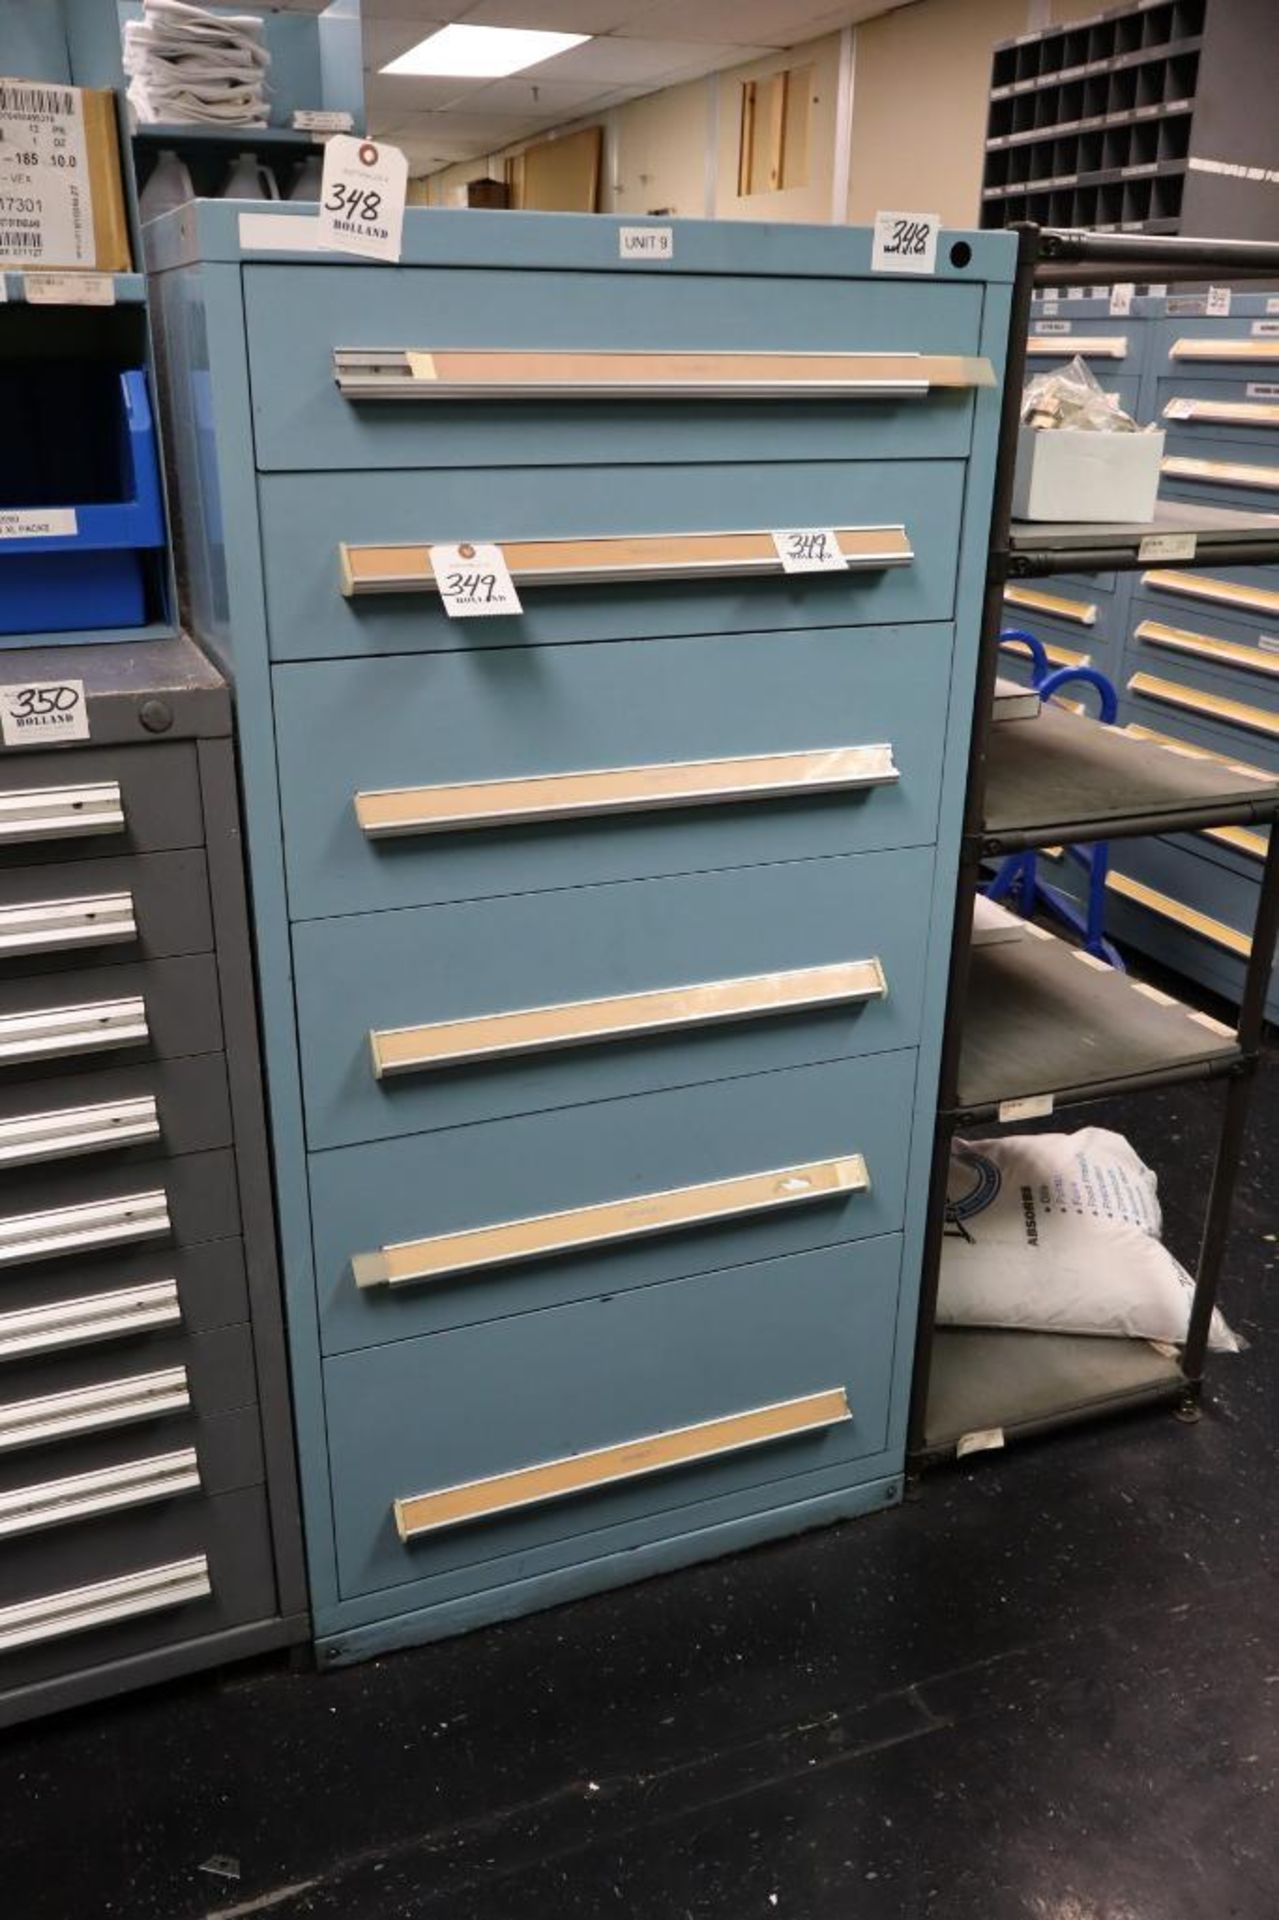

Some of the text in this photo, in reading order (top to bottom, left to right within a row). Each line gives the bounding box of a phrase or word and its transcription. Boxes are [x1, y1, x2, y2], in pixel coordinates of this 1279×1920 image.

[324, 183, 382, 221] 348
[332, 219, 389, 239] HOLLAND
[624, 235, 668, 250] UNIT 9
[892, 219, 930, 254] 348
[787, 533, 827, 562] 349
[440, 572, 496, 603] 349
[10, 687, 80, 718] 350
[16, 713, 75, 728] HOLLAND
